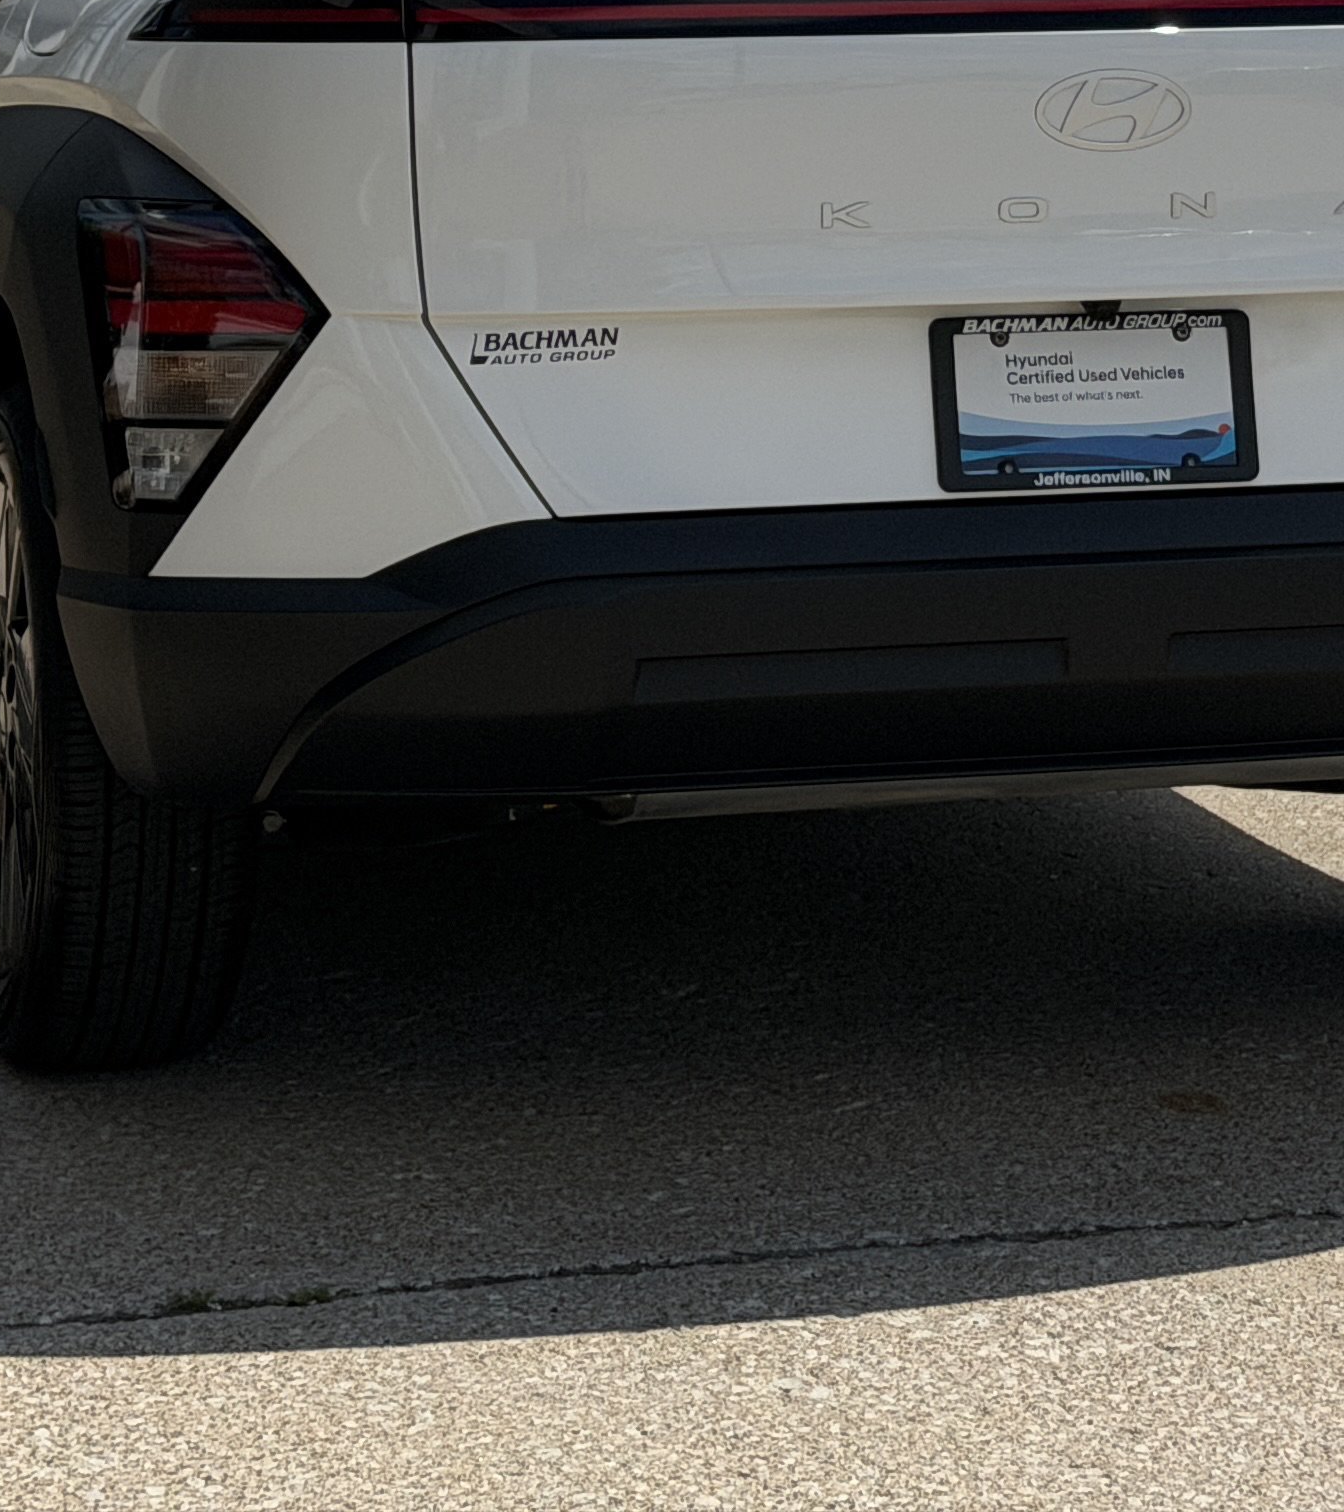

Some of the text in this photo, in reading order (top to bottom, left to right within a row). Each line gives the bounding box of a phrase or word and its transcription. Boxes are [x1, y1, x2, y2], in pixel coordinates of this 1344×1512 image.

[962, 317, 1069, 333] BACHMAN
[484, 327, 619, 352] BACHMAN
[490, 349, 616, 365] AUTO GROUP
[1005, 350, 1073, 370] Hyundai
[1006, 365, 1185, 385] Certified Used Vehicles
[1009, 389, 1143, 404] The best of what's next.
[1034, 468, 1171, 486] Jeffersonville, IN
